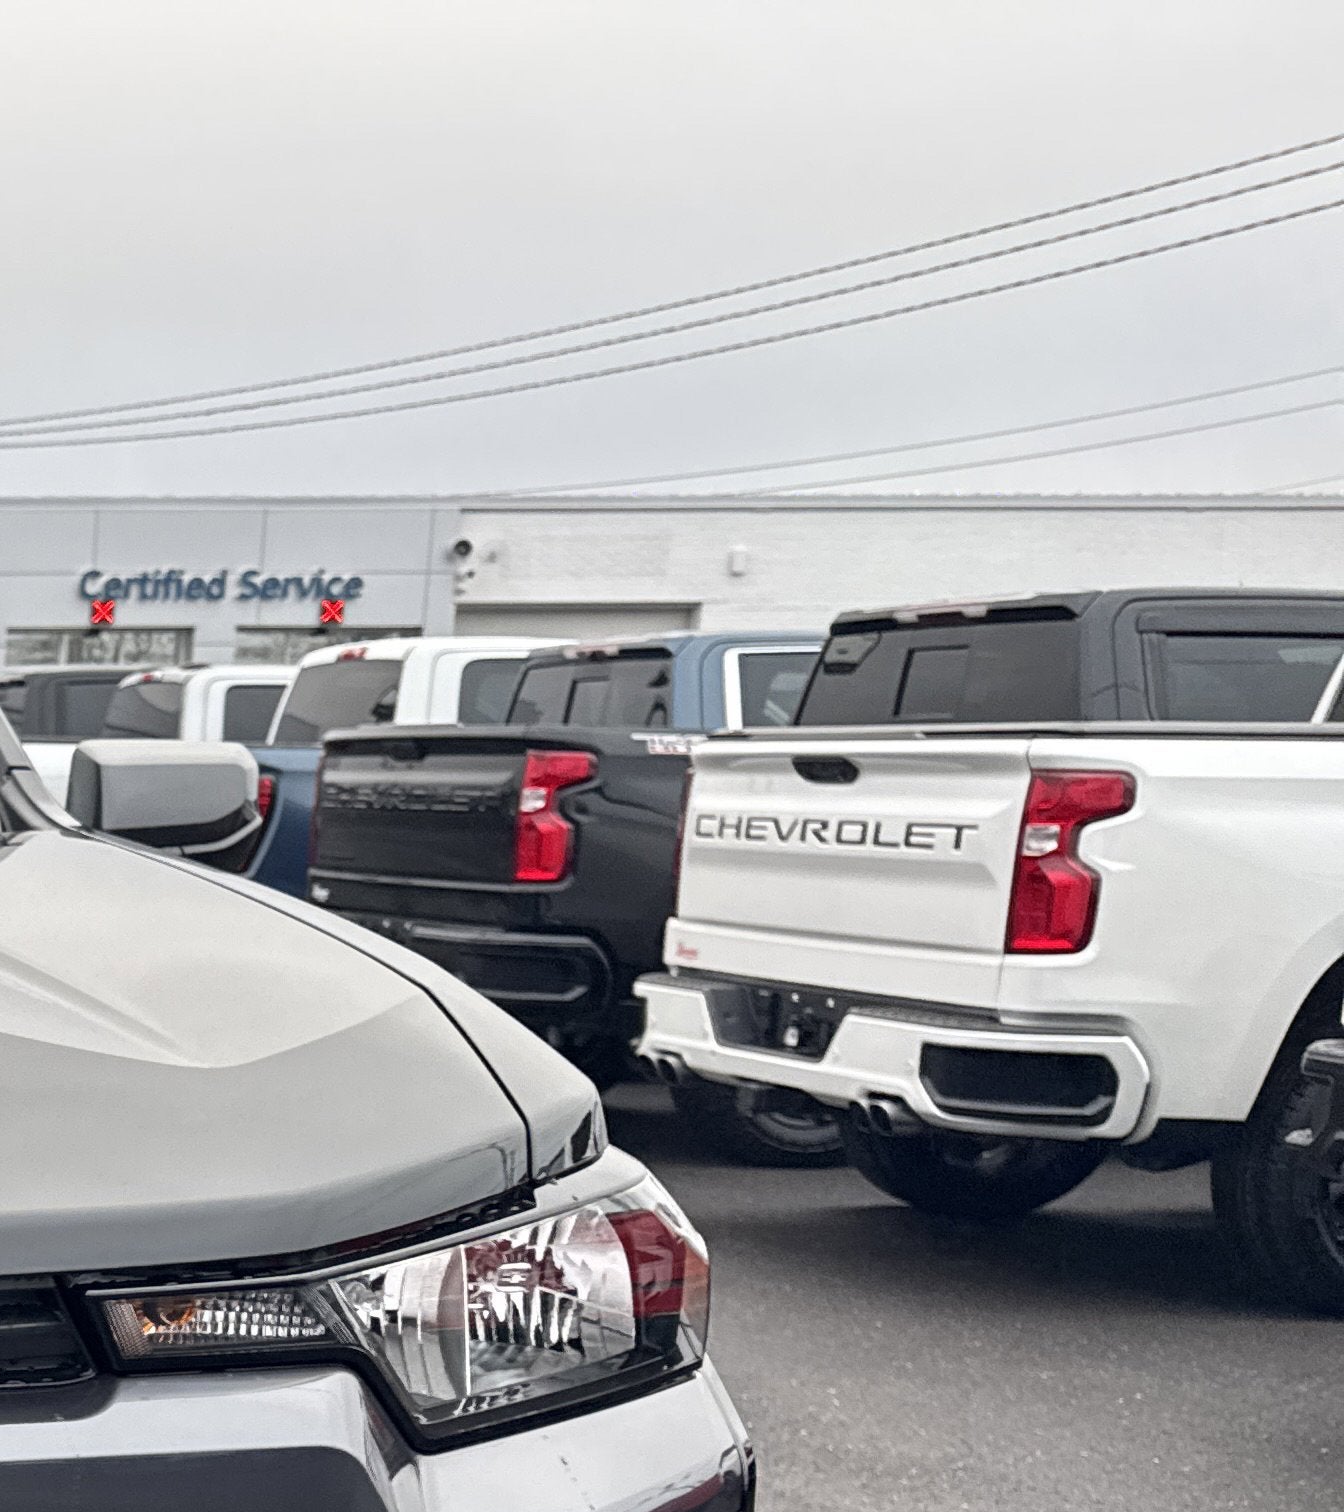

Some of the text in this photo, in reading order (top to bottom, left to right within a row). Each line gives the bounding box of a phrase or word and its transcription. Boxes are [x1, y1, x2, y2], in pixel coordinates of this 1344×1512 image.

[79, 569, 365, 602] Certified Service
[695, 814, 979, 850] CHEVROLET
